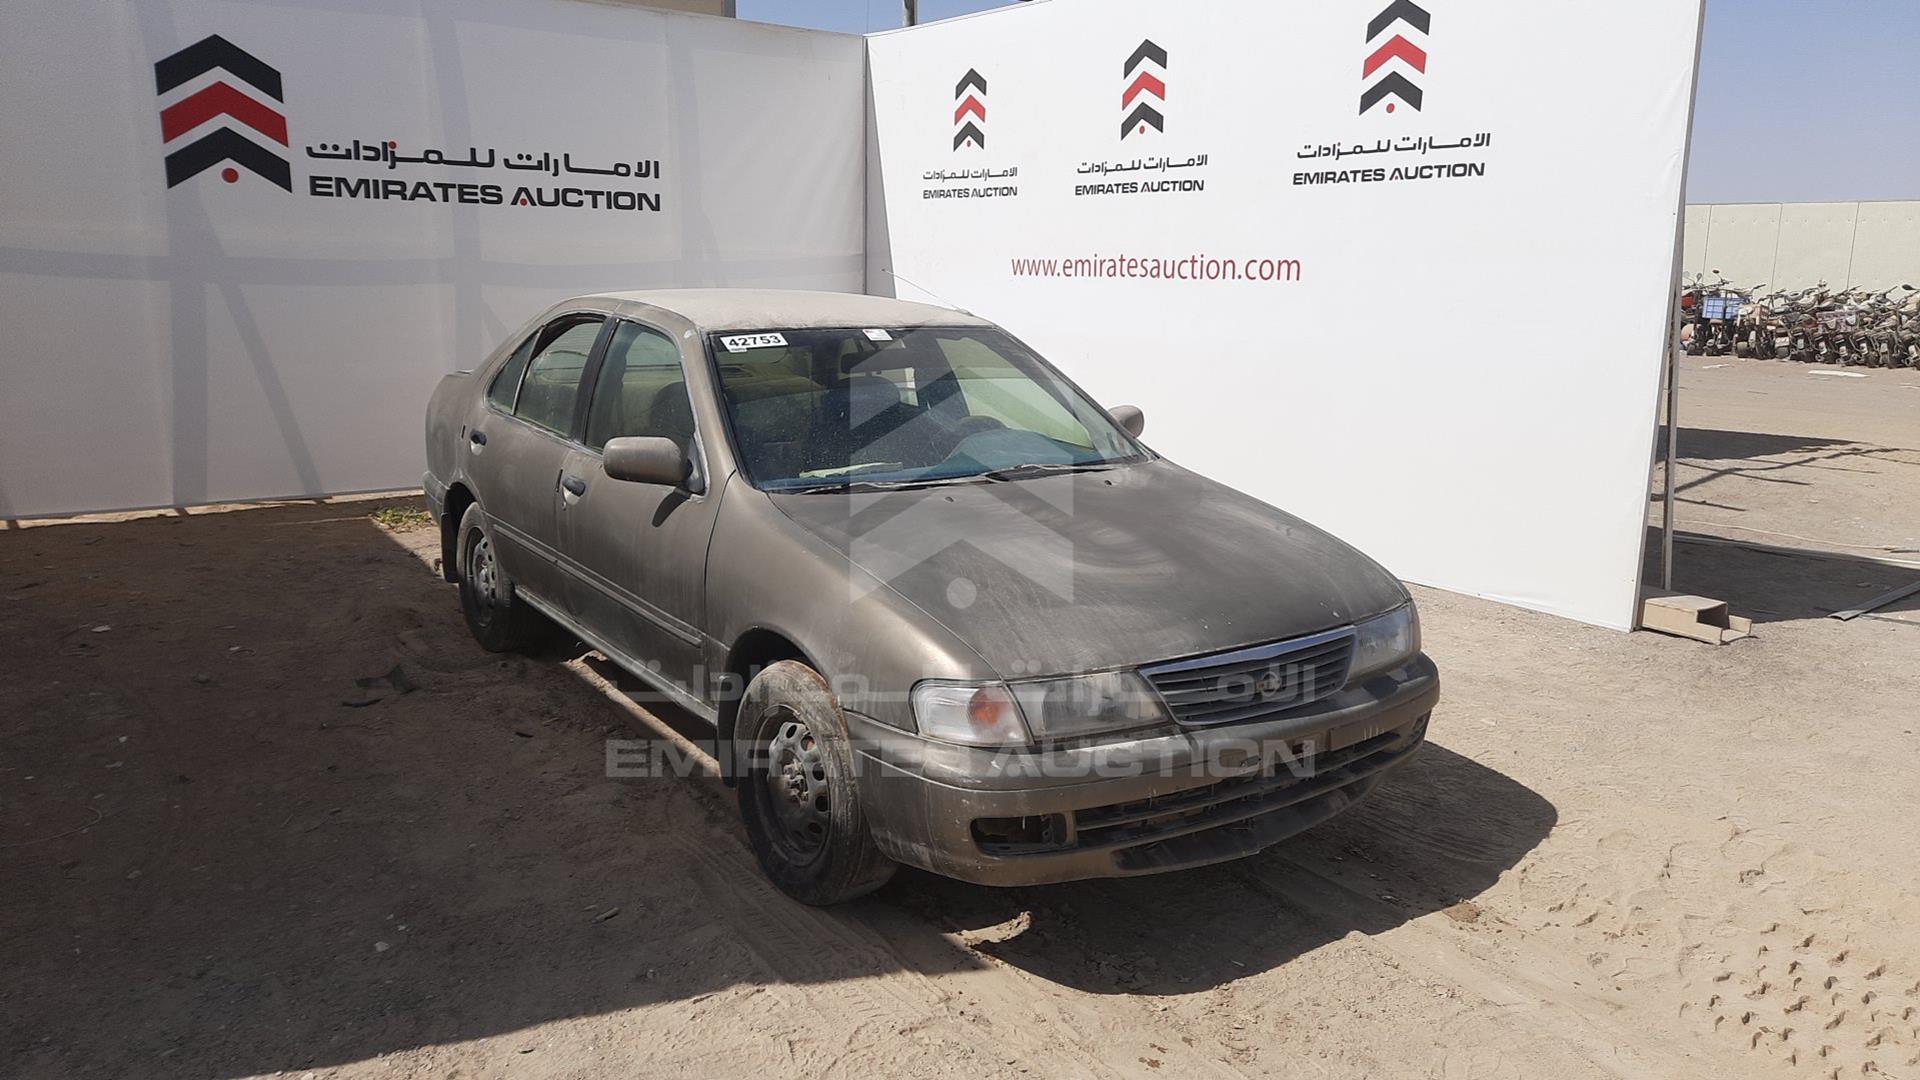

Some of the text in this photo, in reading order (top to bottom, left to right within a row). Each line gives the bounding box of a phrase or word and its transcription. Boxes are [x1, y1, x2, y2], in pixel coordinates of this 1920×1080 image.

[1292, 162, 1486, 185] EMIRATES AUCTION
[309, 175, 660, 211] EMIRATES AUCTION
[923, 186, 1018, 199] EMIRATES AUCTION
[1075, 180, 1205, 196] EMIRATES AUCTION
[1011, 253, 1301, 281] www.emiratesauction.com
[728, 335, 782, 347] 42753
